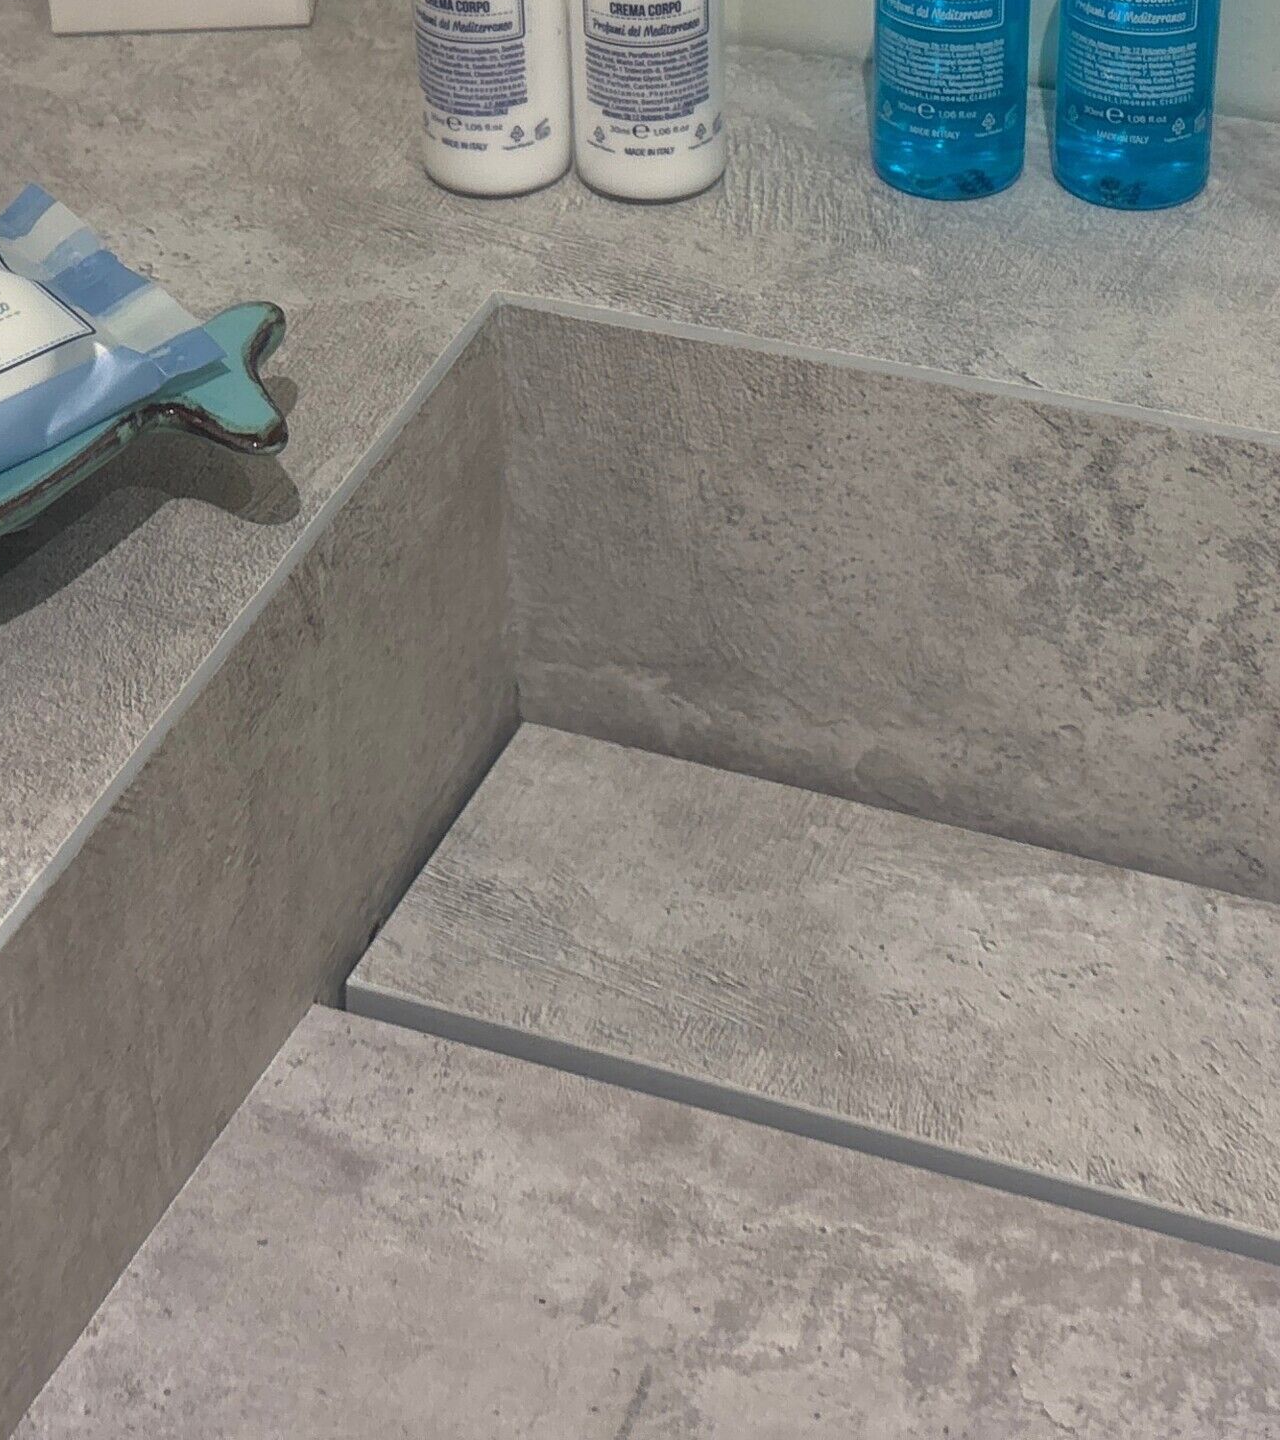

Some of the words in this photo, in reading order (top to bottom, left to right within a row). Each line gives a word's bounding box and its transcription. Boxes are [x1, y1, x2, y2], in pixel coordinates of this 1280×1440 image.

[456, 0, 490, 13] CORPO
[609, 2, 645, 17] CREMA
[648, 0, 682, 16] CORPO
